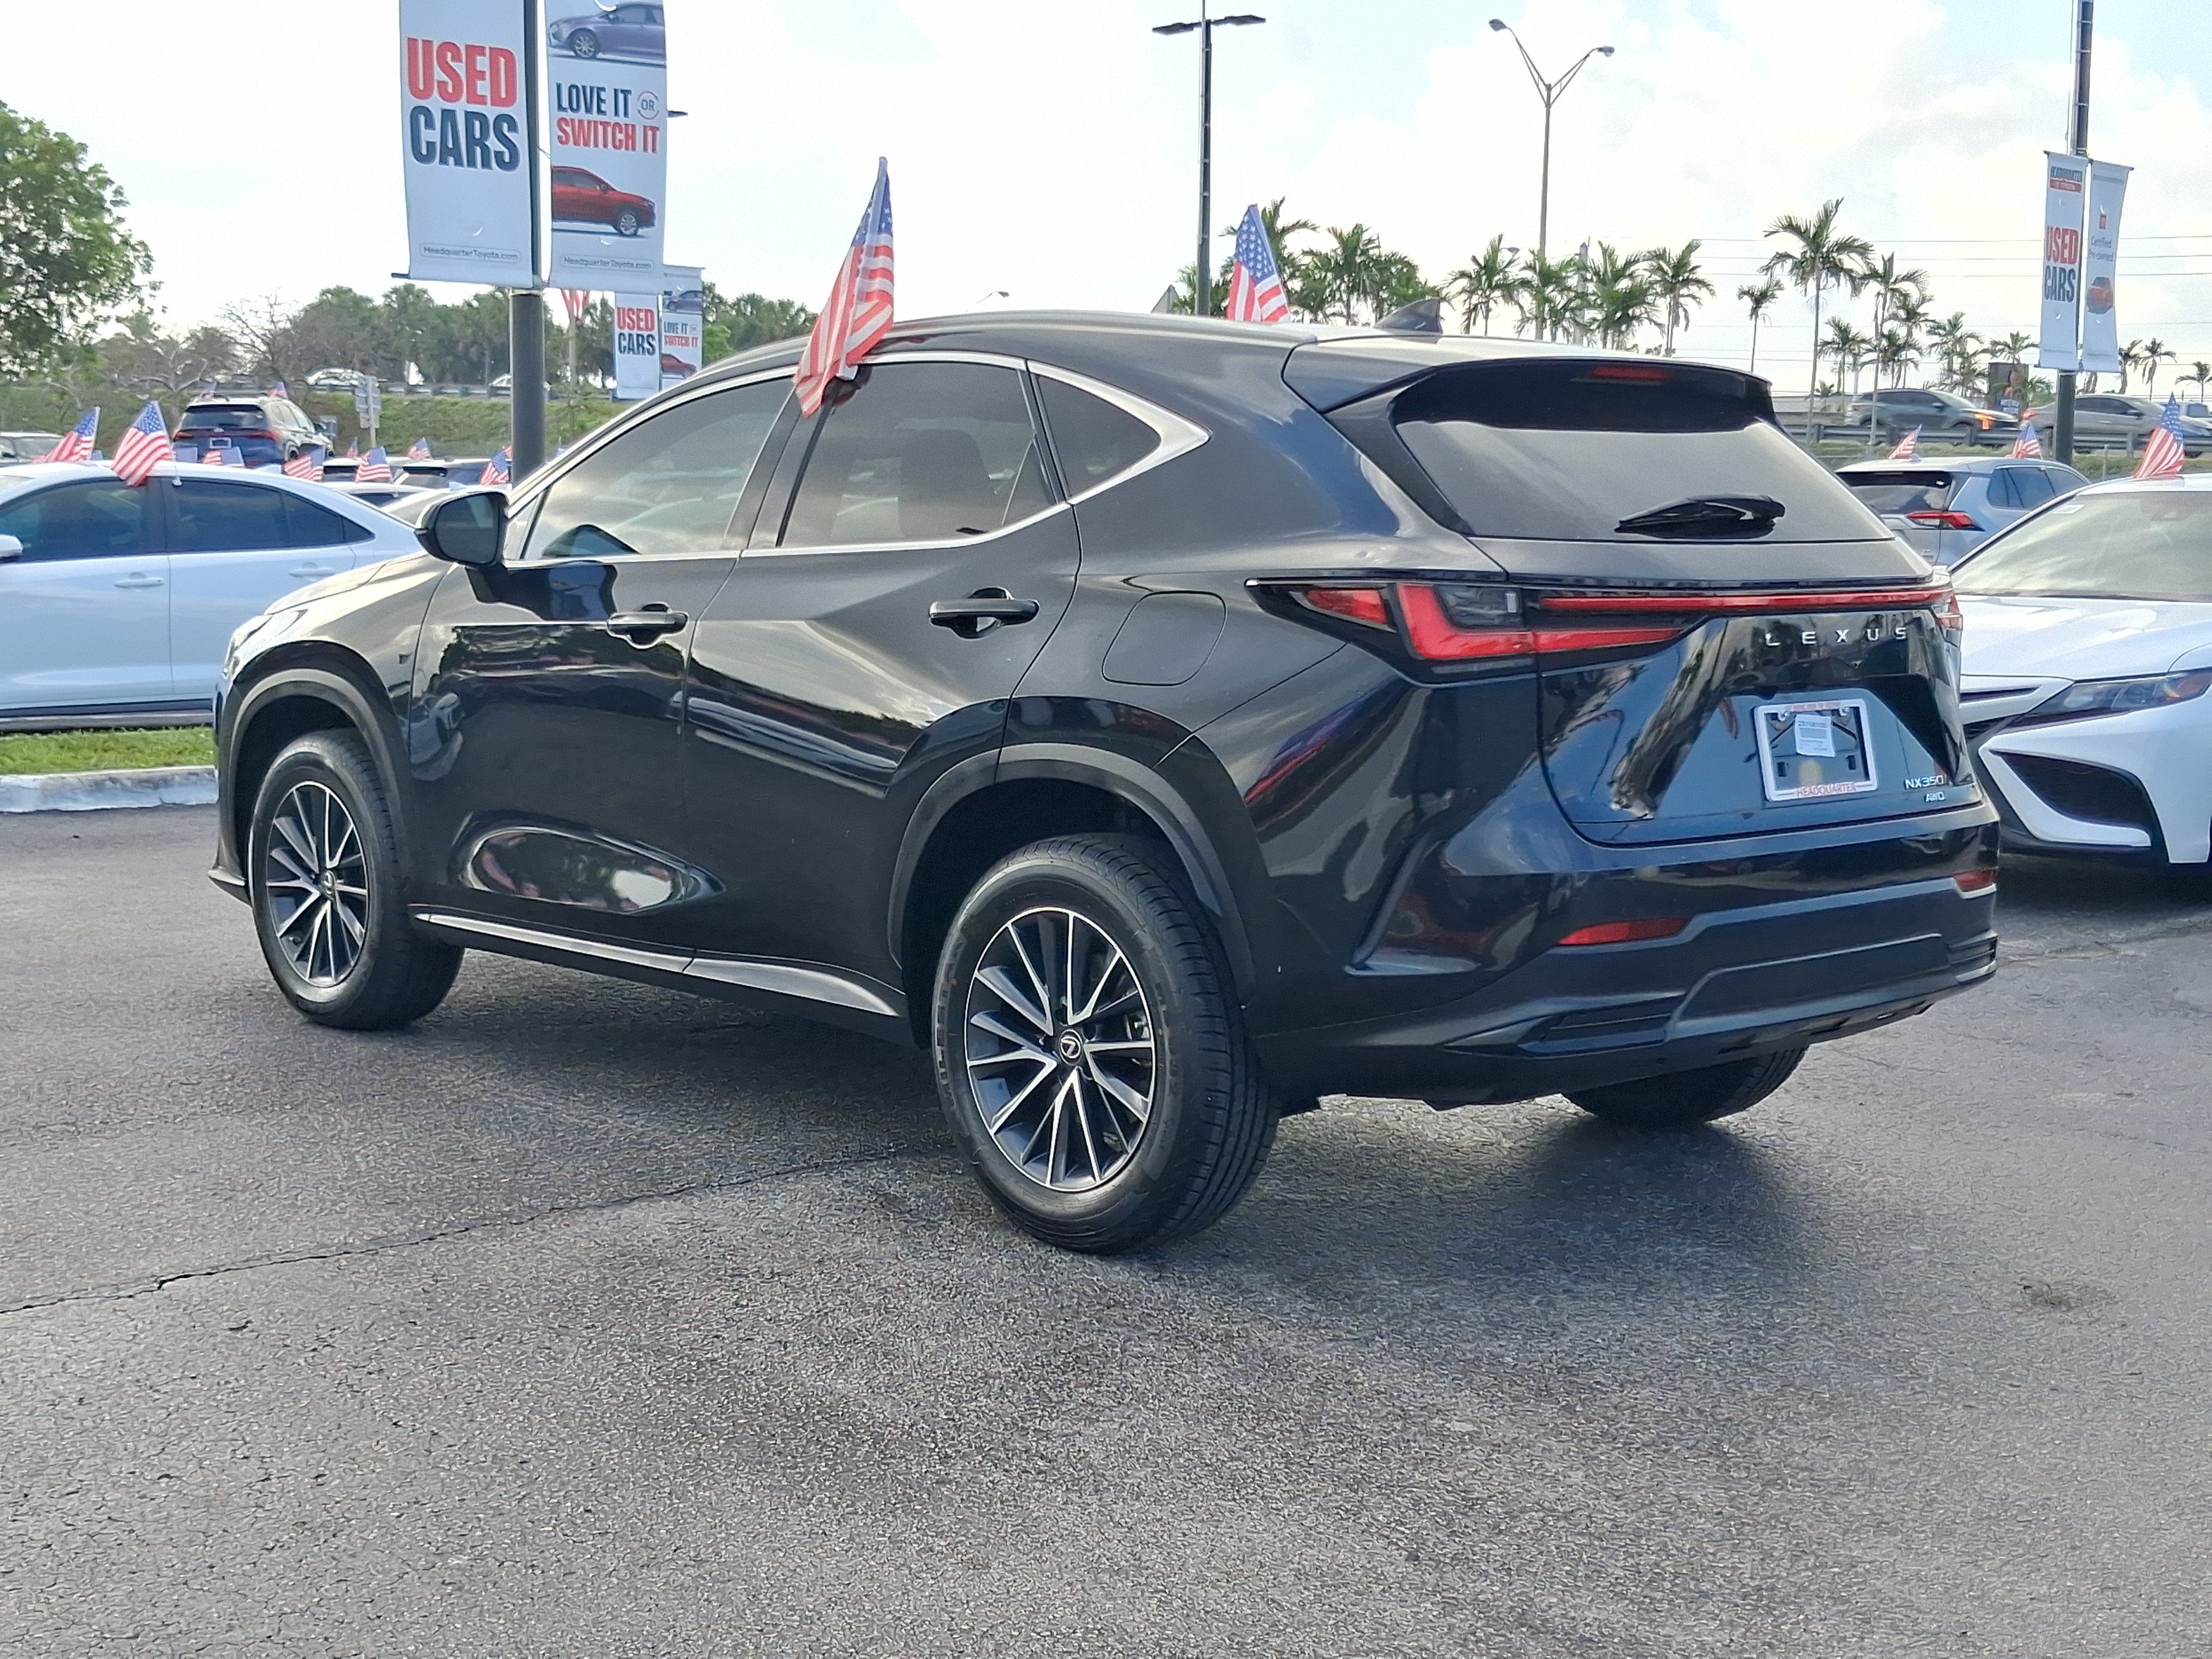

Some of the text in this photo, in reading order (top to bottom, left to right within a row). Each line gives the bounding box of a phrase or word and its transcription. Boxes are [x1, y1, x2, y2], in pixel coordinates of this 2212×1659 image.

[407, 37, 518, 108] USED
[556, 82, 655, 118] LOVE IT OR
[410, 105, 521, 172] CARS
[556, 117, 660, 154] SWITCH IT
[423, 246, 518, 259] HeadquarterToyota.com
[2046, 225, 2079, 265] USED
[2044, 265, 2076, 303] CARS
[617, 307, 655, 332] USED
[664, 321, 679, 333] LOVE
[681, 323, 689, 335] IT
[618, 332, 657, 356] CARS
[664, 335, 699, 348] SWITCH IT
[1765, 627, 1907, 646] LEXUS
[1797, 782, 1857, 797] HEADQUARTER
[1905, 774, 1944, 789] NX350
[1925, 792, 1945, 802] AWD
